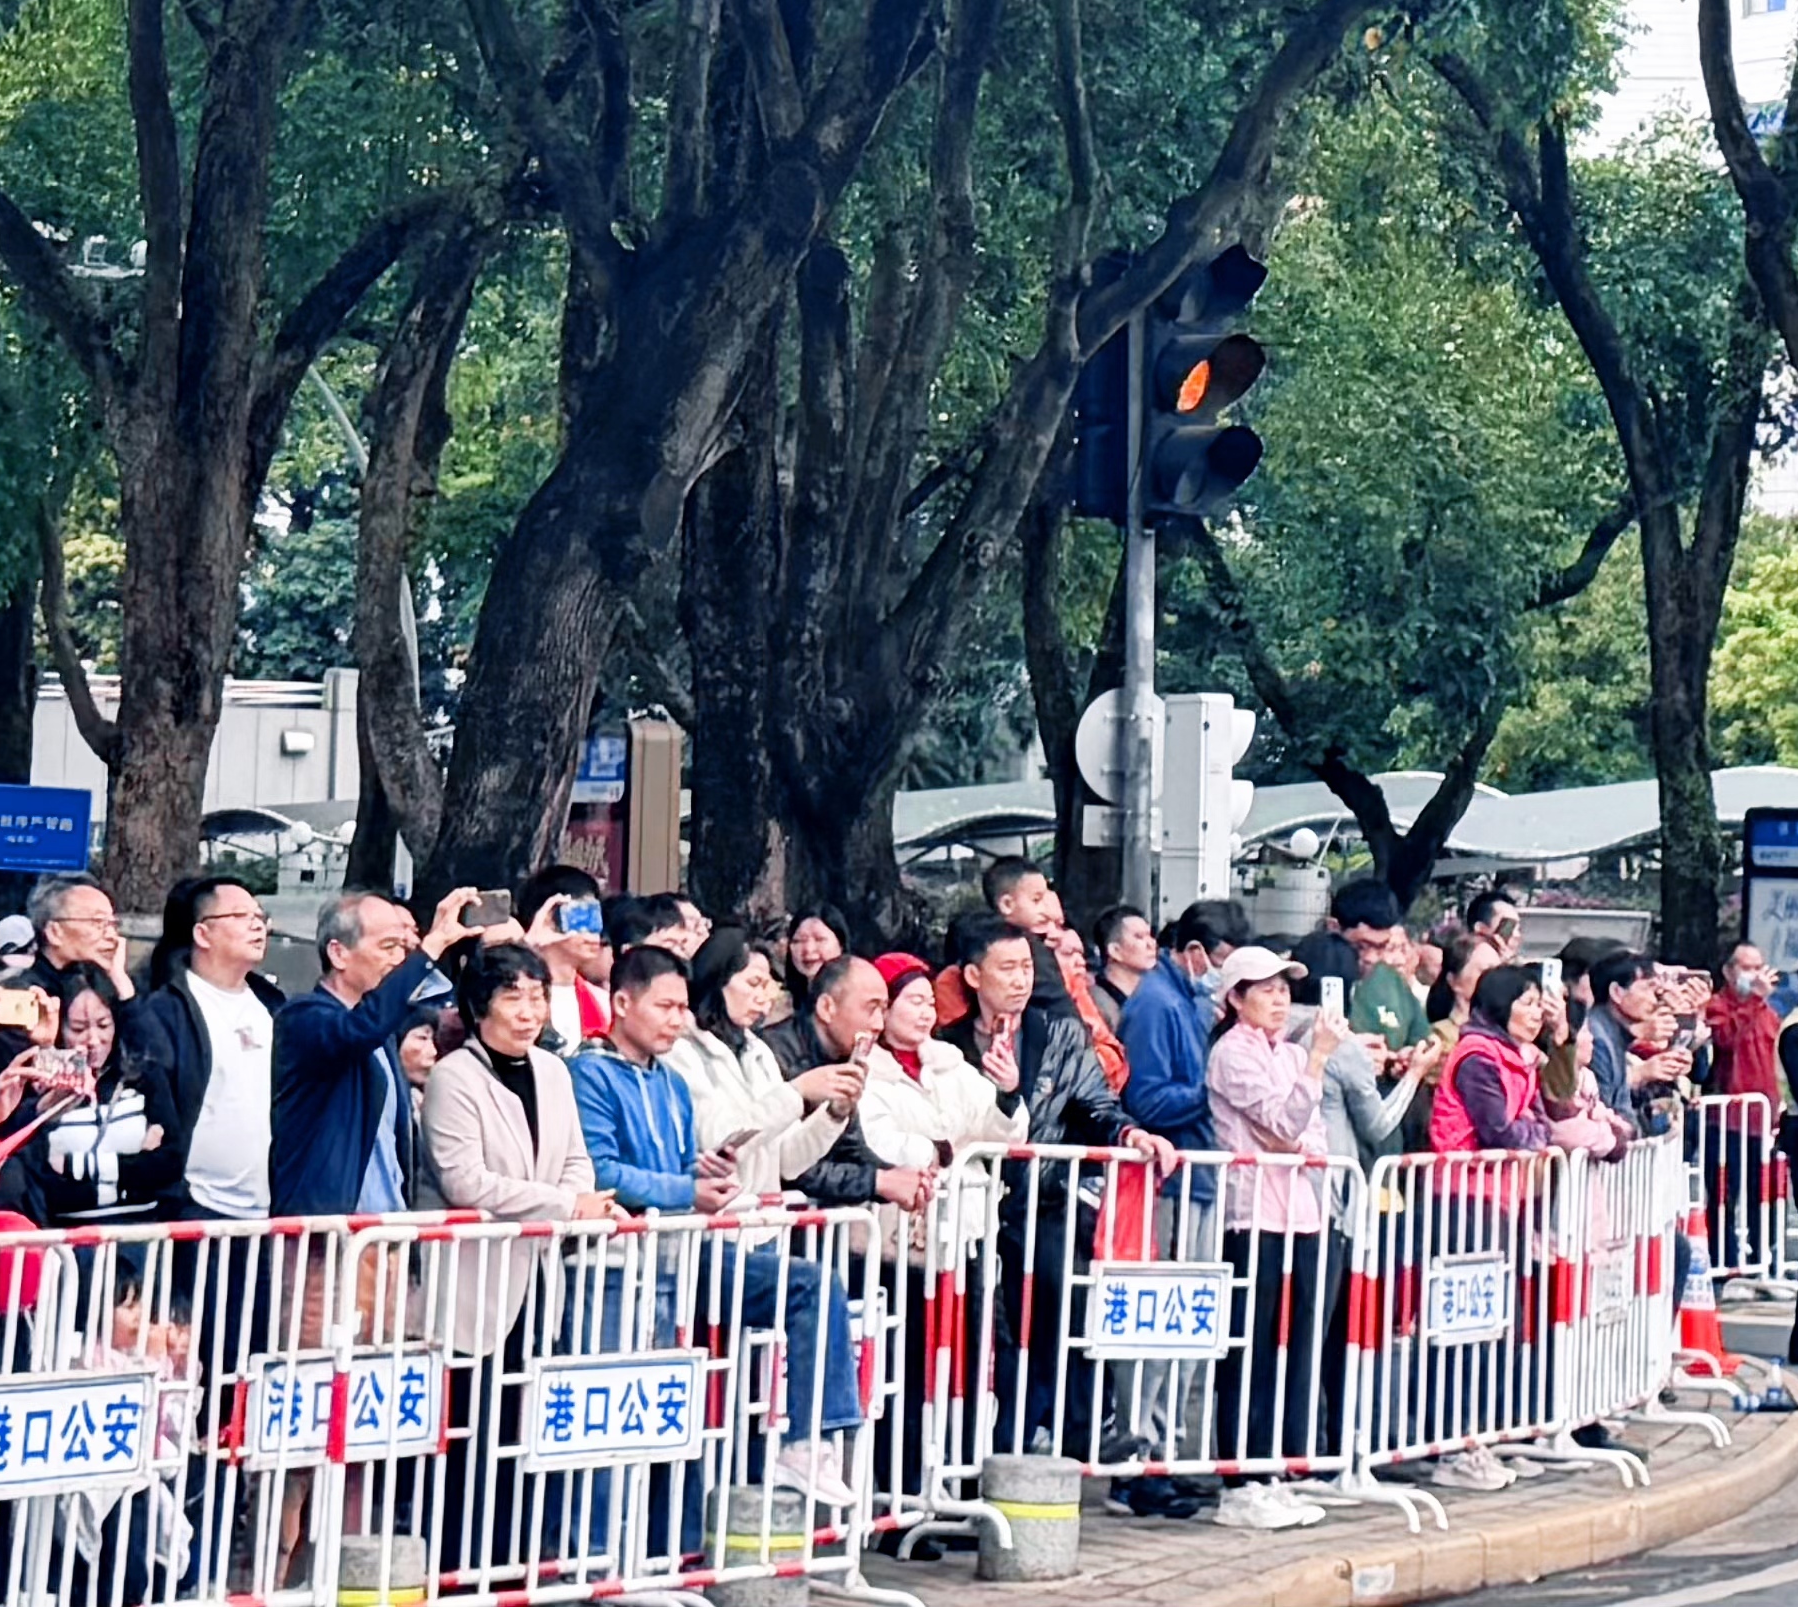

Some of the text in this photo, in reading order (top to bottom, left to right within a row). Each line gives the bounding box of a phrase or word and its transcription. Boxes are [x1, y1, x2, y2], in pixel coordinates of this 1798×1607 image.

[1102, 1282, 1215, 1335] 港口公安
[542, 1374, 687, 1442] 港口公安
